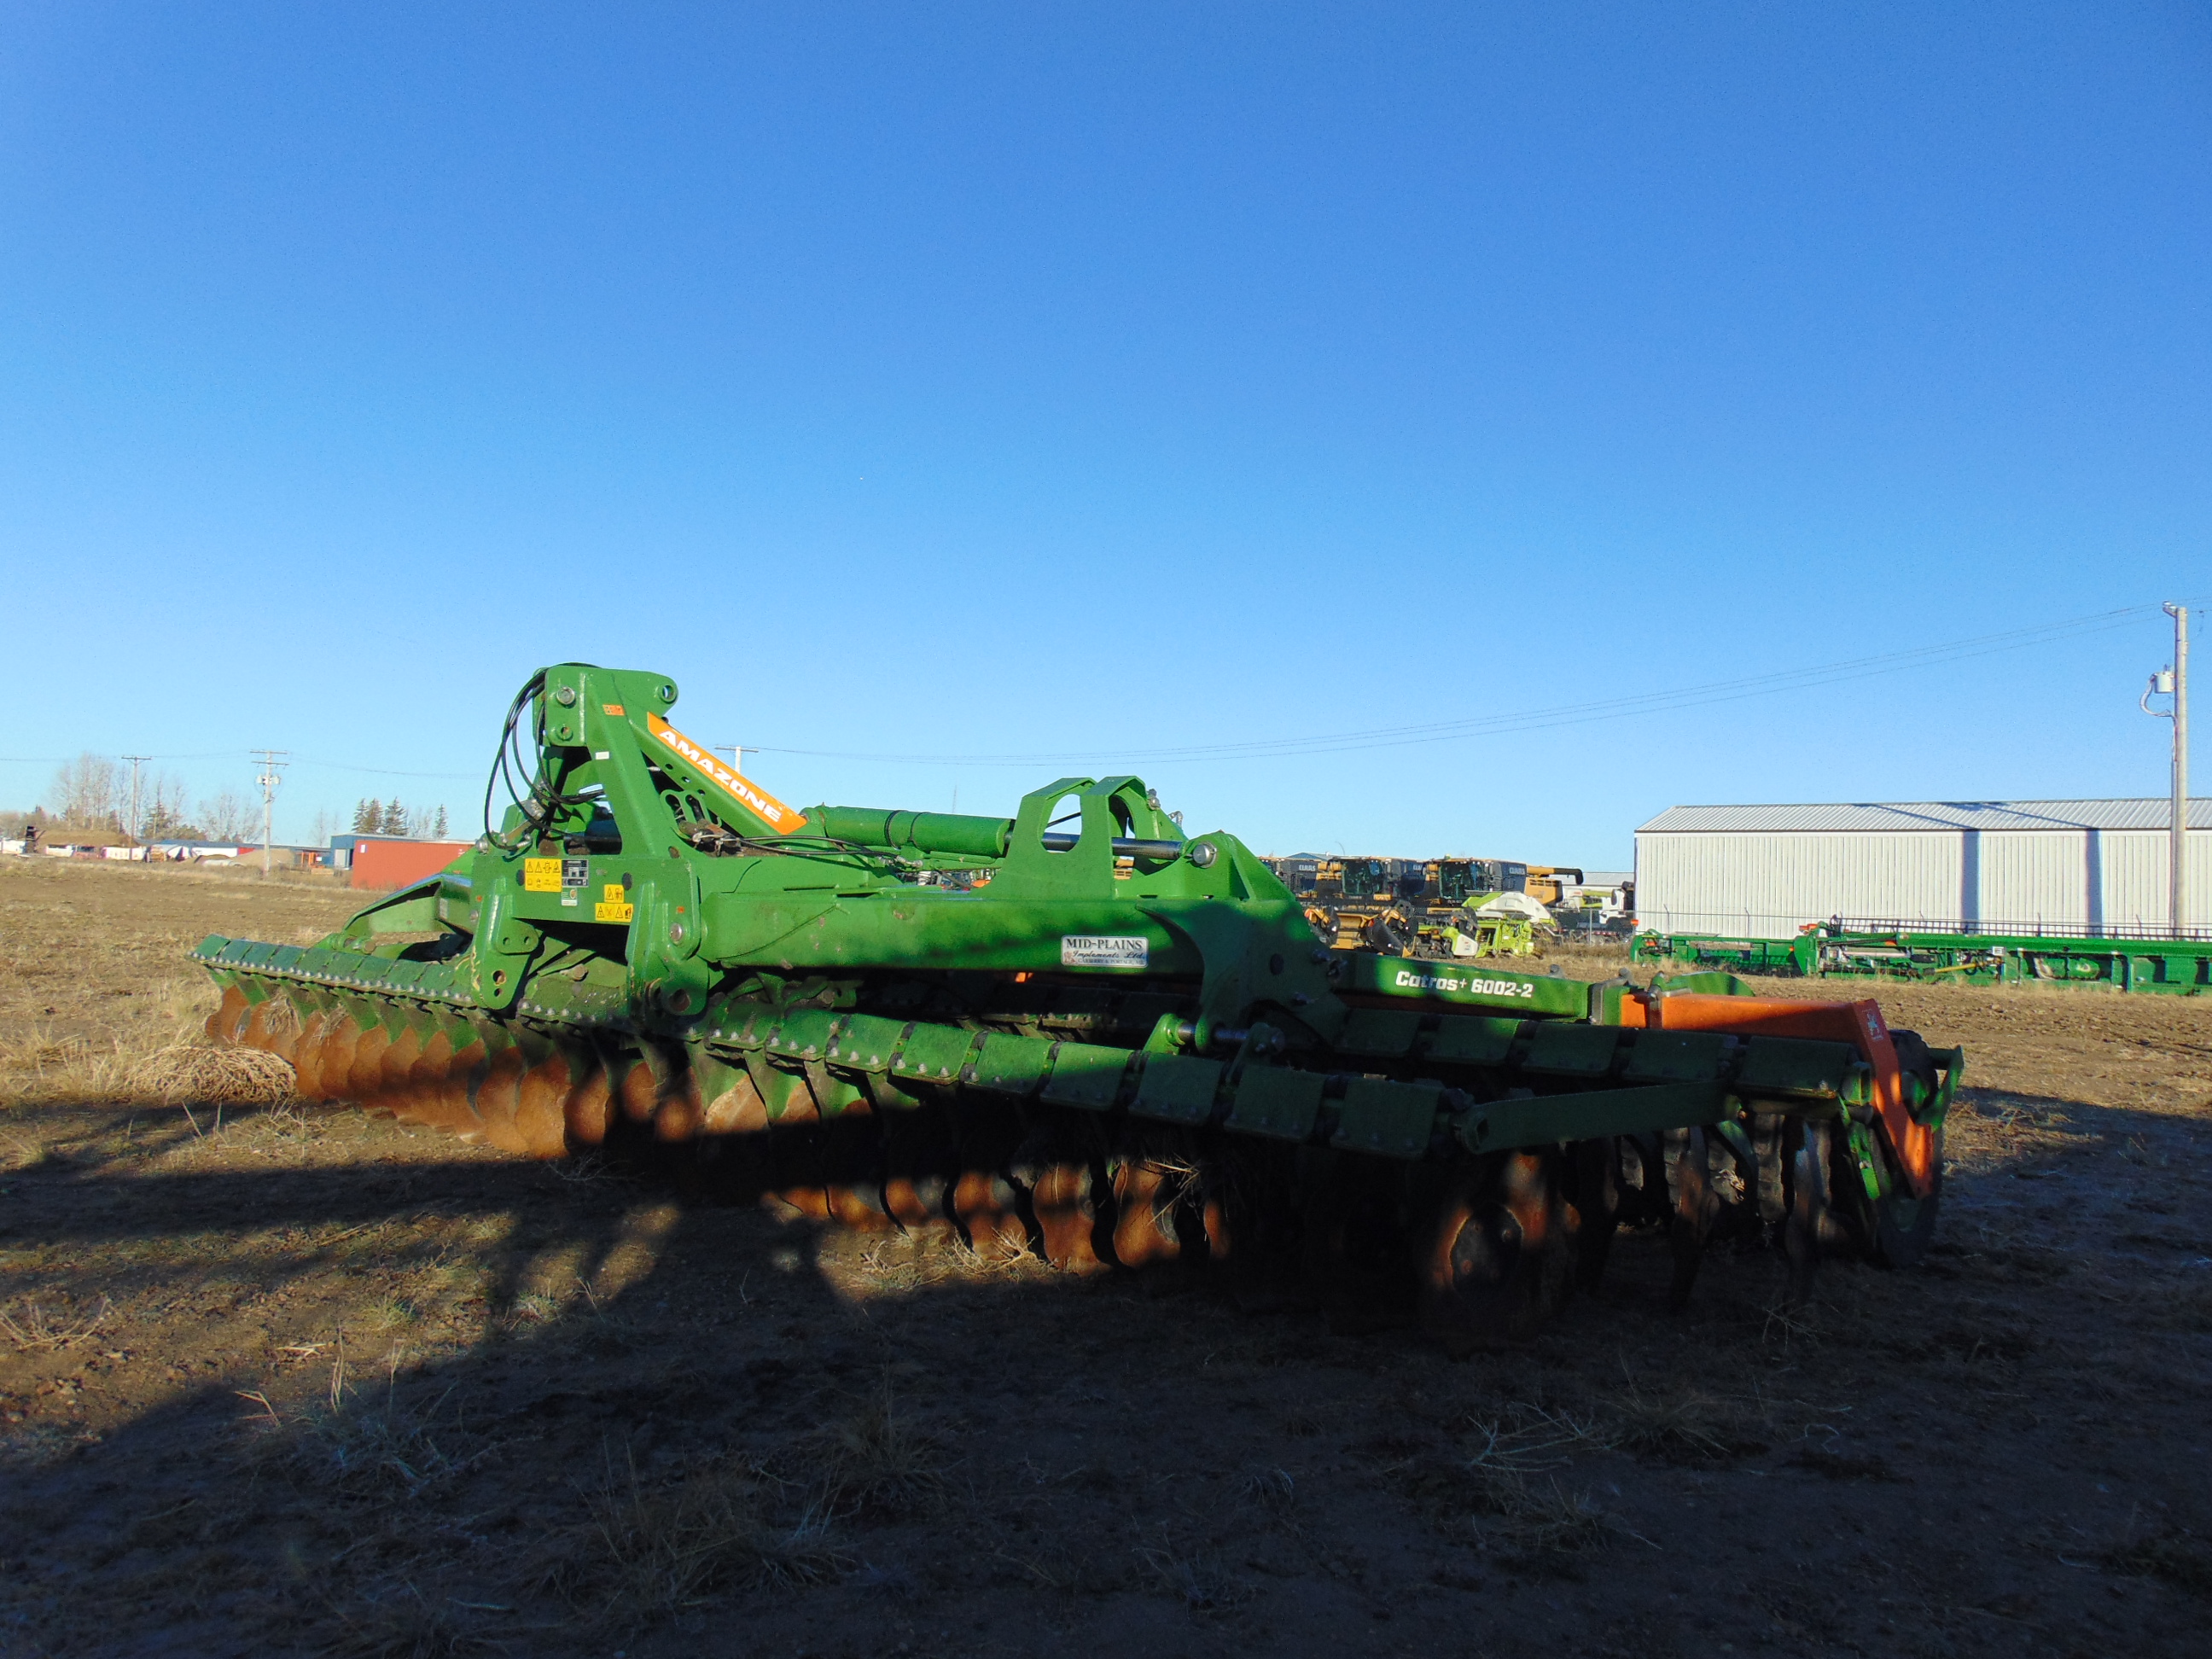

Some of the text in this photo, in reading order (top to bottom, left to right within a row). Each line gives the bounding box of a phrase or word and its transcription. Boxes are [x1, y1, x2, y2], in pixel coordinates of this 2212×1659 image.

[659, 731, 782, 823] AMAZONE
[1066, 938, 1143, 950] MID-PLAINS
[1073, 950, 1120, 959] Implements
[1470, 978, 1534, 998] 6002-2
